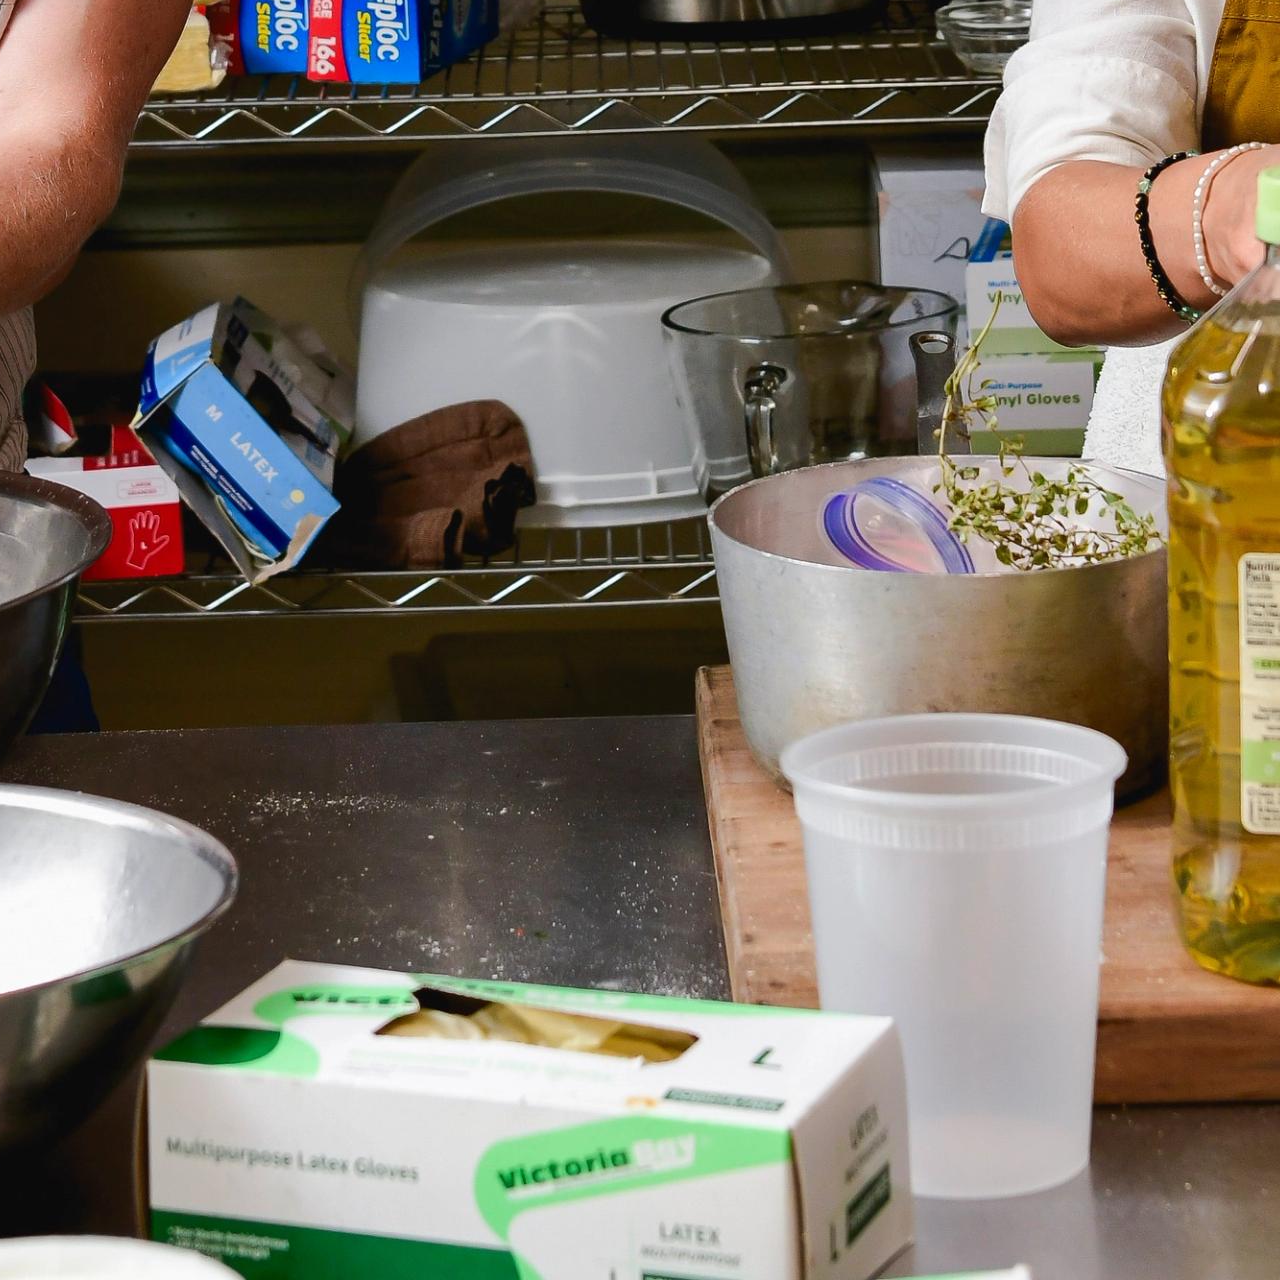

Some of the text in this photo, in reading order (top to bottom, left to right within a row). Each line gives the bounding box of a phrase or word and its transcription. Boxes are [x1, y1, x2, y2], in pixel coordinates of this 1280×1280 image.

[256, 1, 271, 54] Slider
[357, 10, 372, 64] Slider
[316, 36, 336, 75] 166
[986, 382, 1043, 390] ulti-Purpose
[1026, 393, 1081, 405] Gloves
[205, 404, 224, 422] M
[230, 431, 279, 483] LATEX
[166, 1137, 420, 1182] Multipurpose Latex Gloves
[497, 1147, 632, 1190] Victoria
[658, 1221, 721, 1245] LATEX
